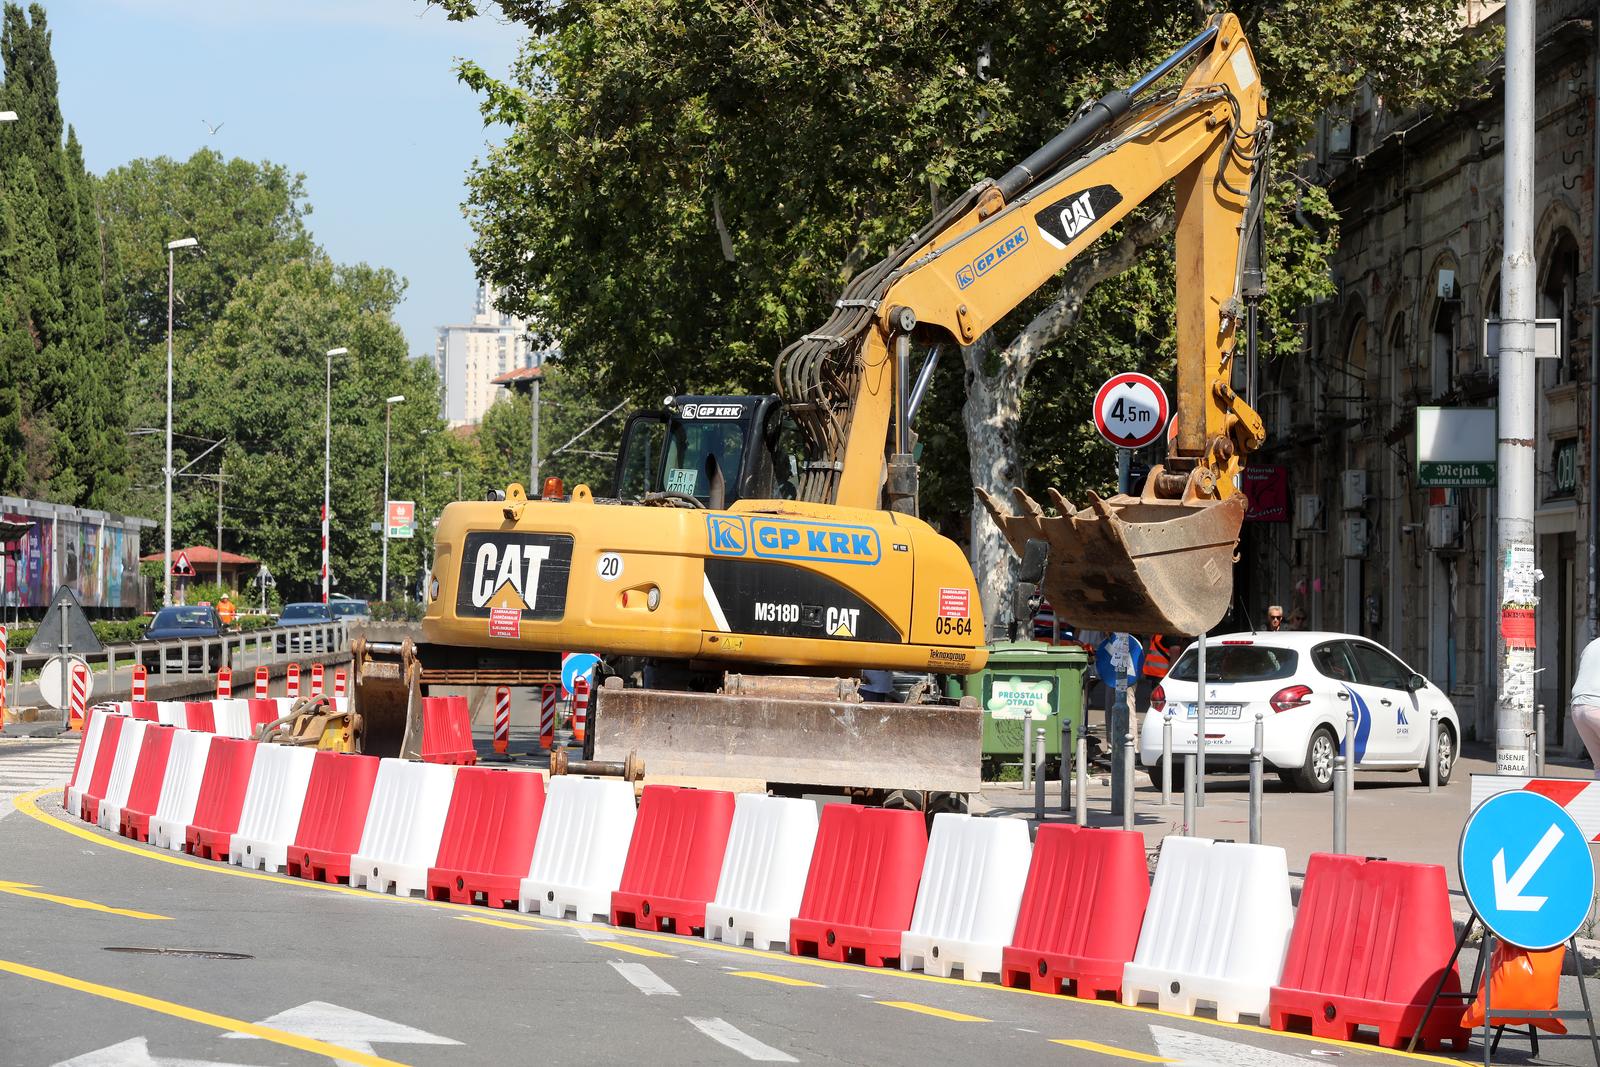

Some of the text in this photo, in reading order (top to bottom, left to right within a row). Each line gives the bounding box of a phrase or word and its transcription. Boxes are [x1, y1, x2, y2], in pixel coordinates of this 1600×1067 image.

[1059, 190, 1096, 239] CAT
[976, 252, 995, 272] GP
[995, 231, 1027, 259] KRK
[699, 407, 715, 416] GP
[715, 407, 740, 416] KRK
[1436, 464, 1479, 479] Mejak
[758, 526, 800, 550] GP
[806, 530, 873, 556] KRK
[472, 542, 551, 611] CAT
[601, 557, 619, 576] 20
[754, 602, 800, 623] M318D
[825, 606, 860, 638] CAT
[936, 616, 972, 636] 05-64
[998, 691, 1043, 700] PREOSTALI
[1006, 699, 1035, 707] OTPAD
